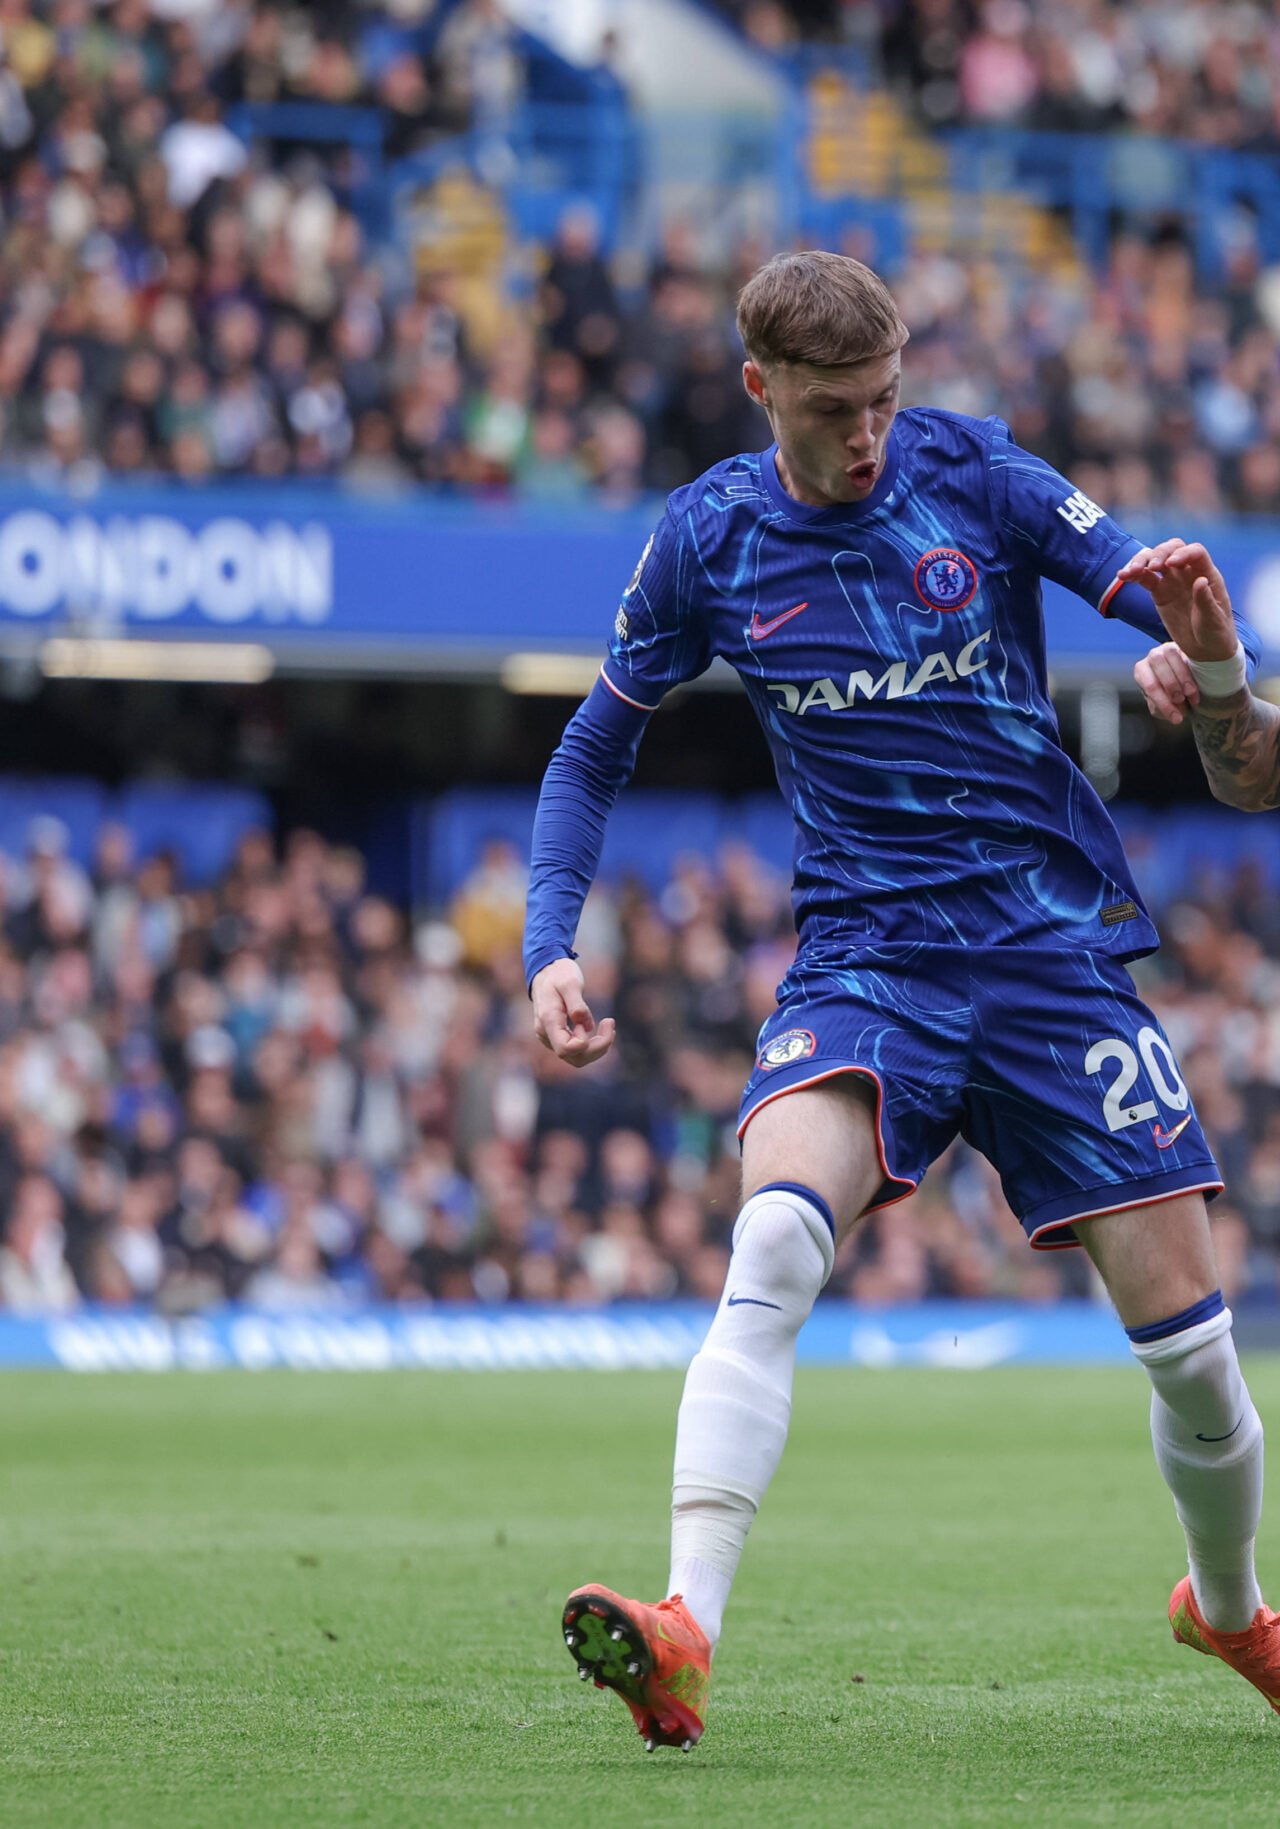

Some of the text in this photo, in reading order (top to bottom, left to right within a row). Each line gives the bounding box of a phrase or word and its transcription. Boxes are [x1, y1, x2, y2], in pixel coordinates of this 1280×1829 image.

[1056, 490, 1091, 523] LIV
[766, 629, 992, 716] DAMAC
[1084, 1026, 1190, 1132] 20
